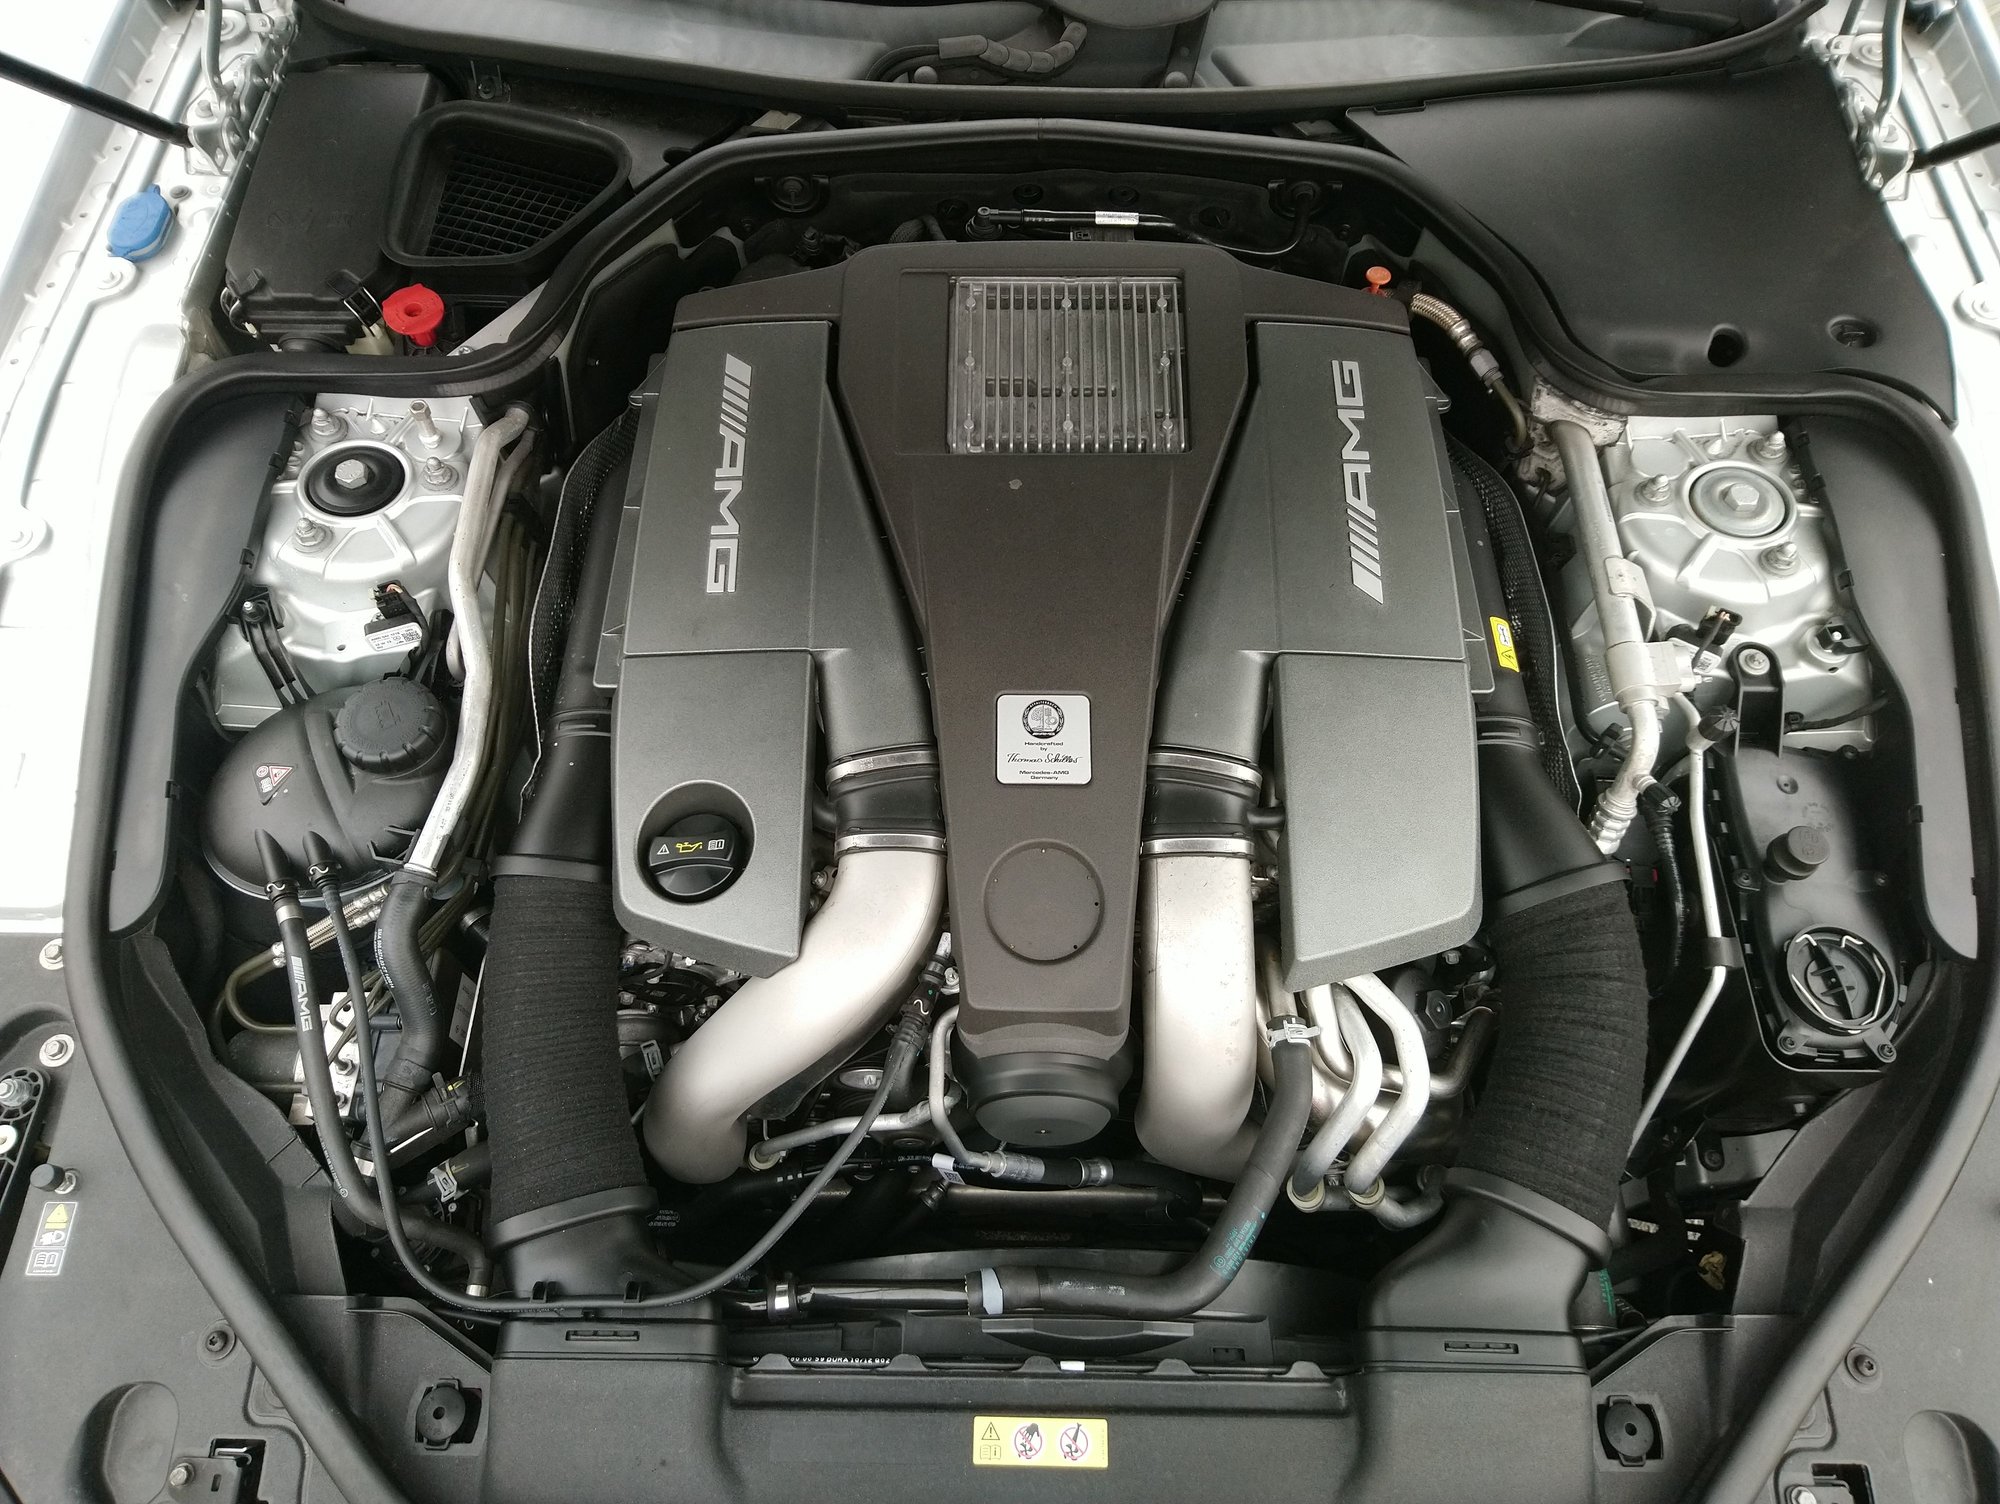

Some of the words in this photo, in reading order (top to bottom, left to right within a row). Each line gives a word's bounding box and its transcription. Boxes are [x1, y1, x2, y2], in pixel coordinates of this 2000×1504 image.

[706, 423, 746, 593] AMG
[1332, 360, 1376, 521] AMG
[295, 979, 313, 1032] AMG
